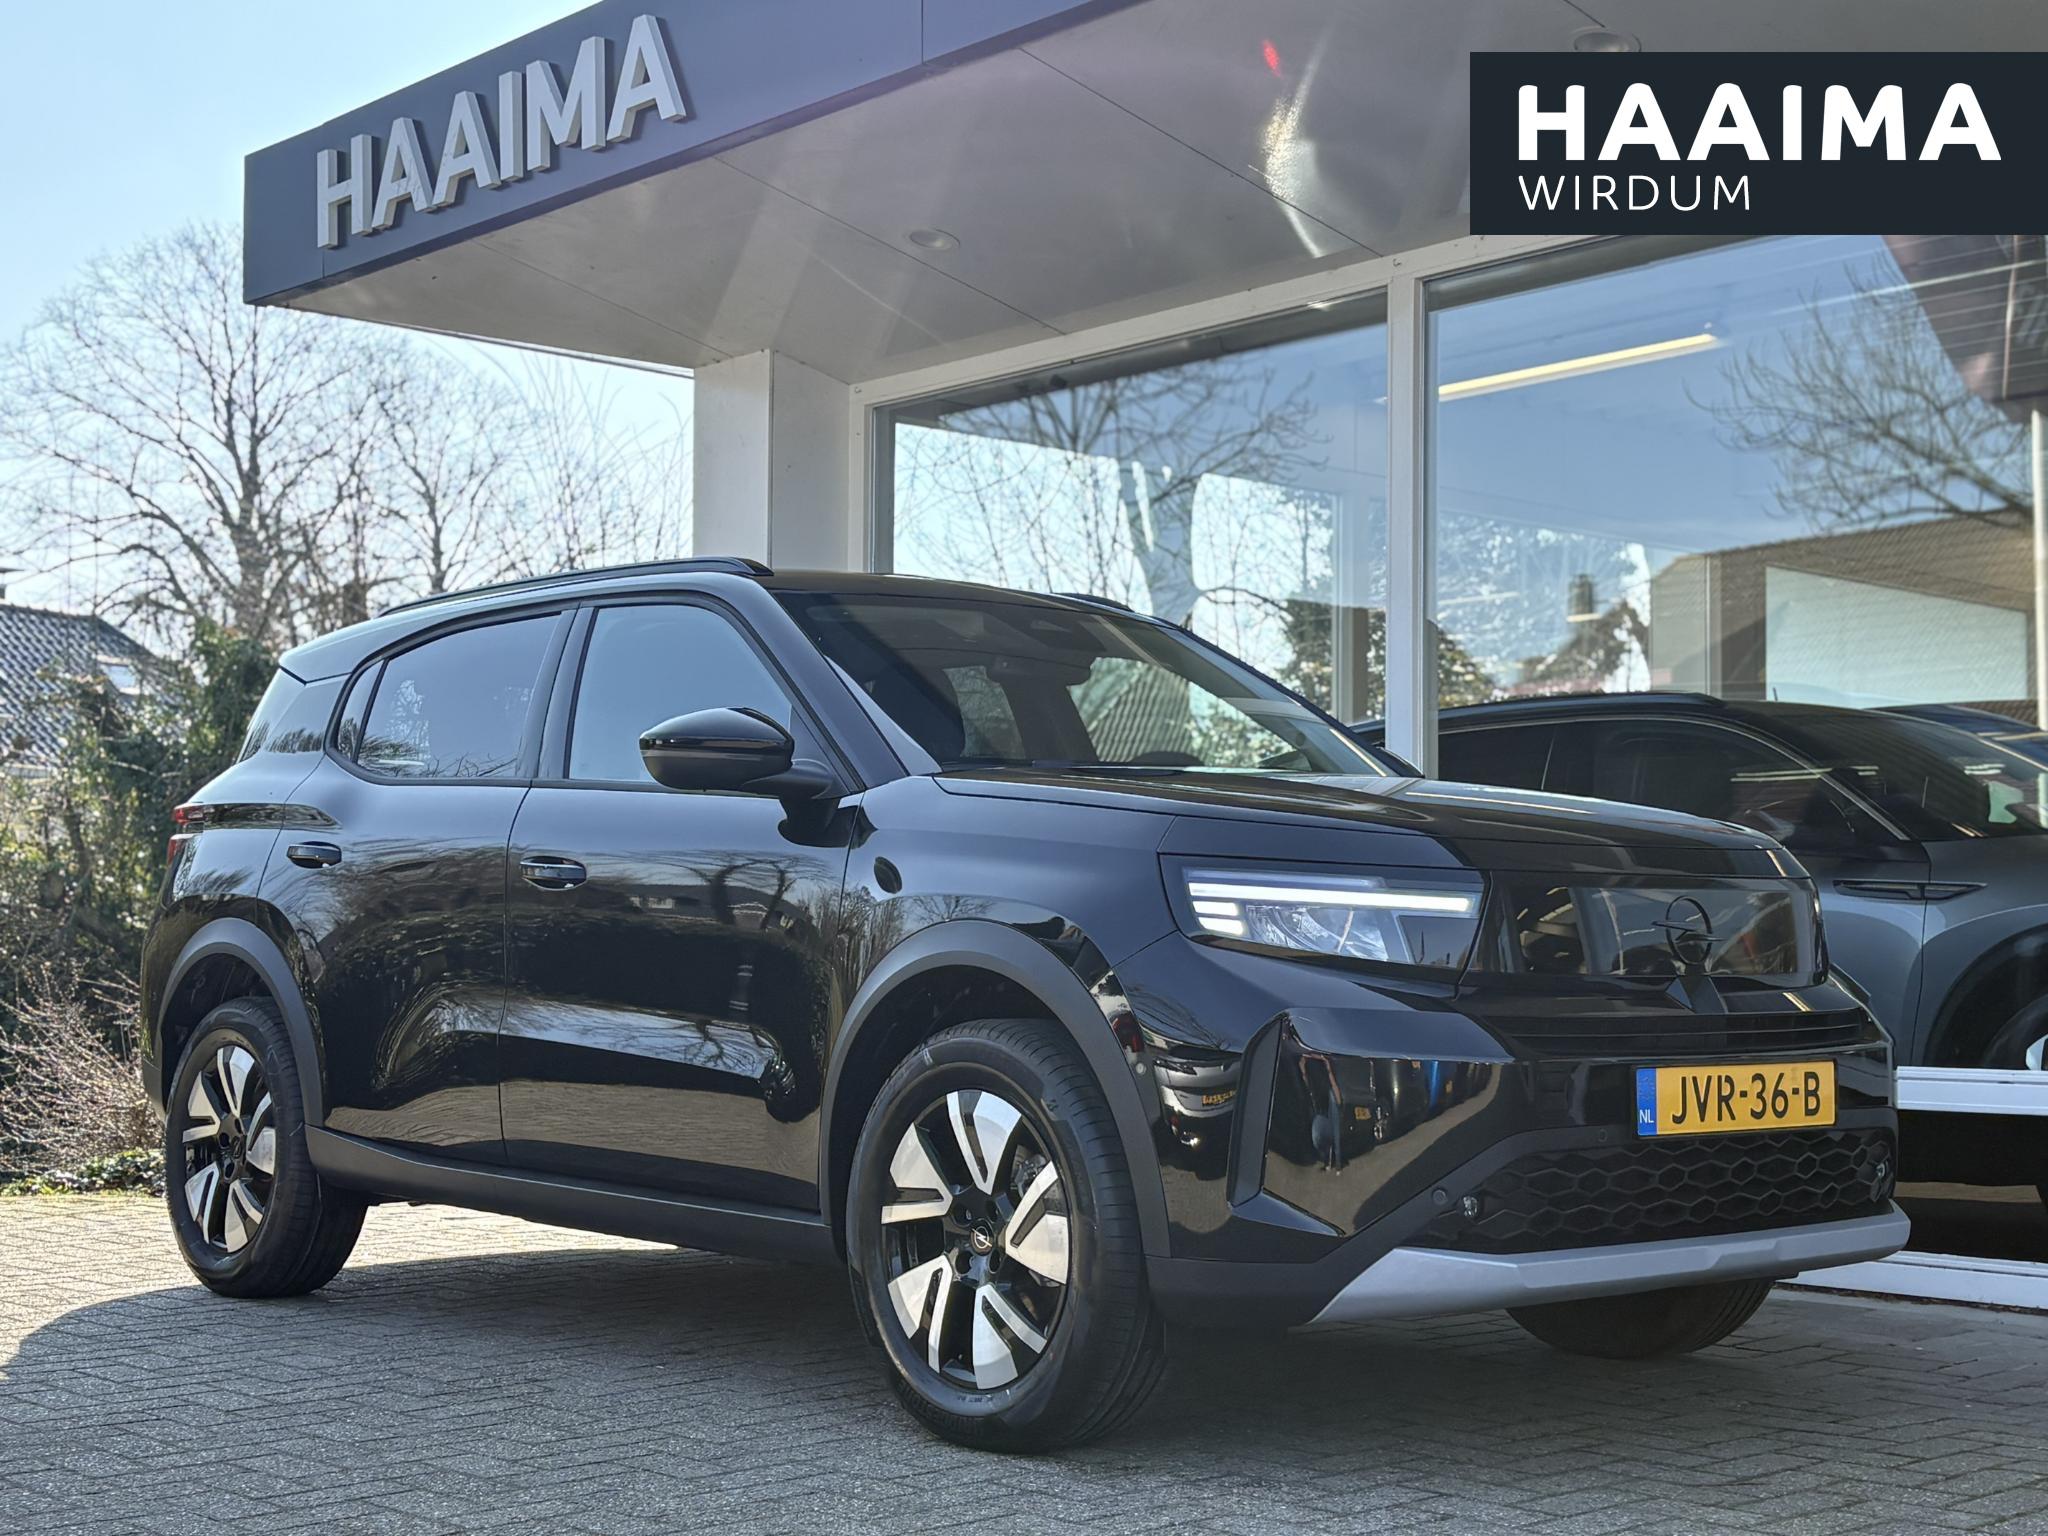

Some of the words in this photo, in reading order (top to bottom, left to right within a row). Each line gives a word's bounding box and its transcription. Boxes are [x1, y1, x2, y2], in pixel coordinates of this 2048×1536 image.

[316, 14, 687, 249] HAAIMA
[1638, 1109, 1654, 1124] NL
[1671, 1071, 1821, 1125] JVR-36-B
